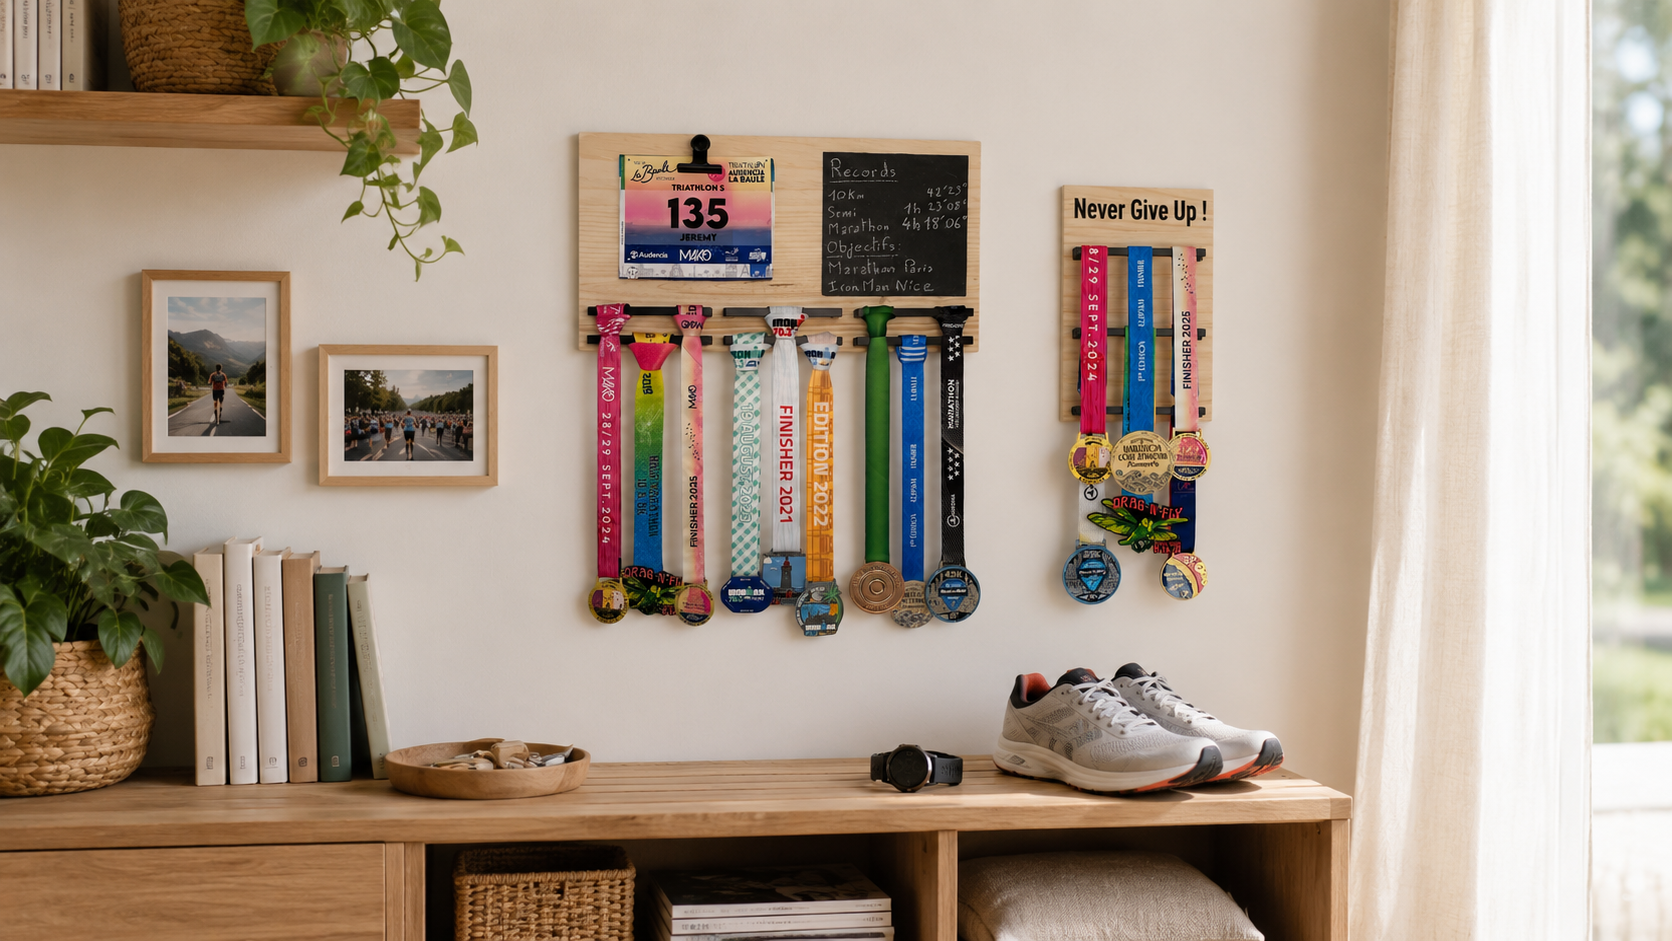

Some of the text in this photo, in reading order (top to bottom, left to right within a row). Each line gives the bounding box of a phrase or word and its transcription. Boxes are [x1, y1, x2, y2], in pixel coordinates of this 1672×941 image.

[830, 157, 897, 178] Records
[672, 184, 725, 192] TRIATHLON S
[667, 197, 729, 229] 135
[1074, 198, 1207, 227] Never Give Up !
[680, 233, 717, 242] JEREMY
[828, 218, 889, 235] Marathon
[638, 251, 668, 259] Audencia
[828, 258, 895, 275] Marathon
[895, 280, 934, 292] Nice
[1181, 311, 1192, 390] FINISHER 2025
[602, 413, 612, 456] 28/29
[779, 405, 793, 523] FINISHER 2021
[813, 401, 830, 527] EDITION 2022
[689, 502, 698, 547] FINISHER
